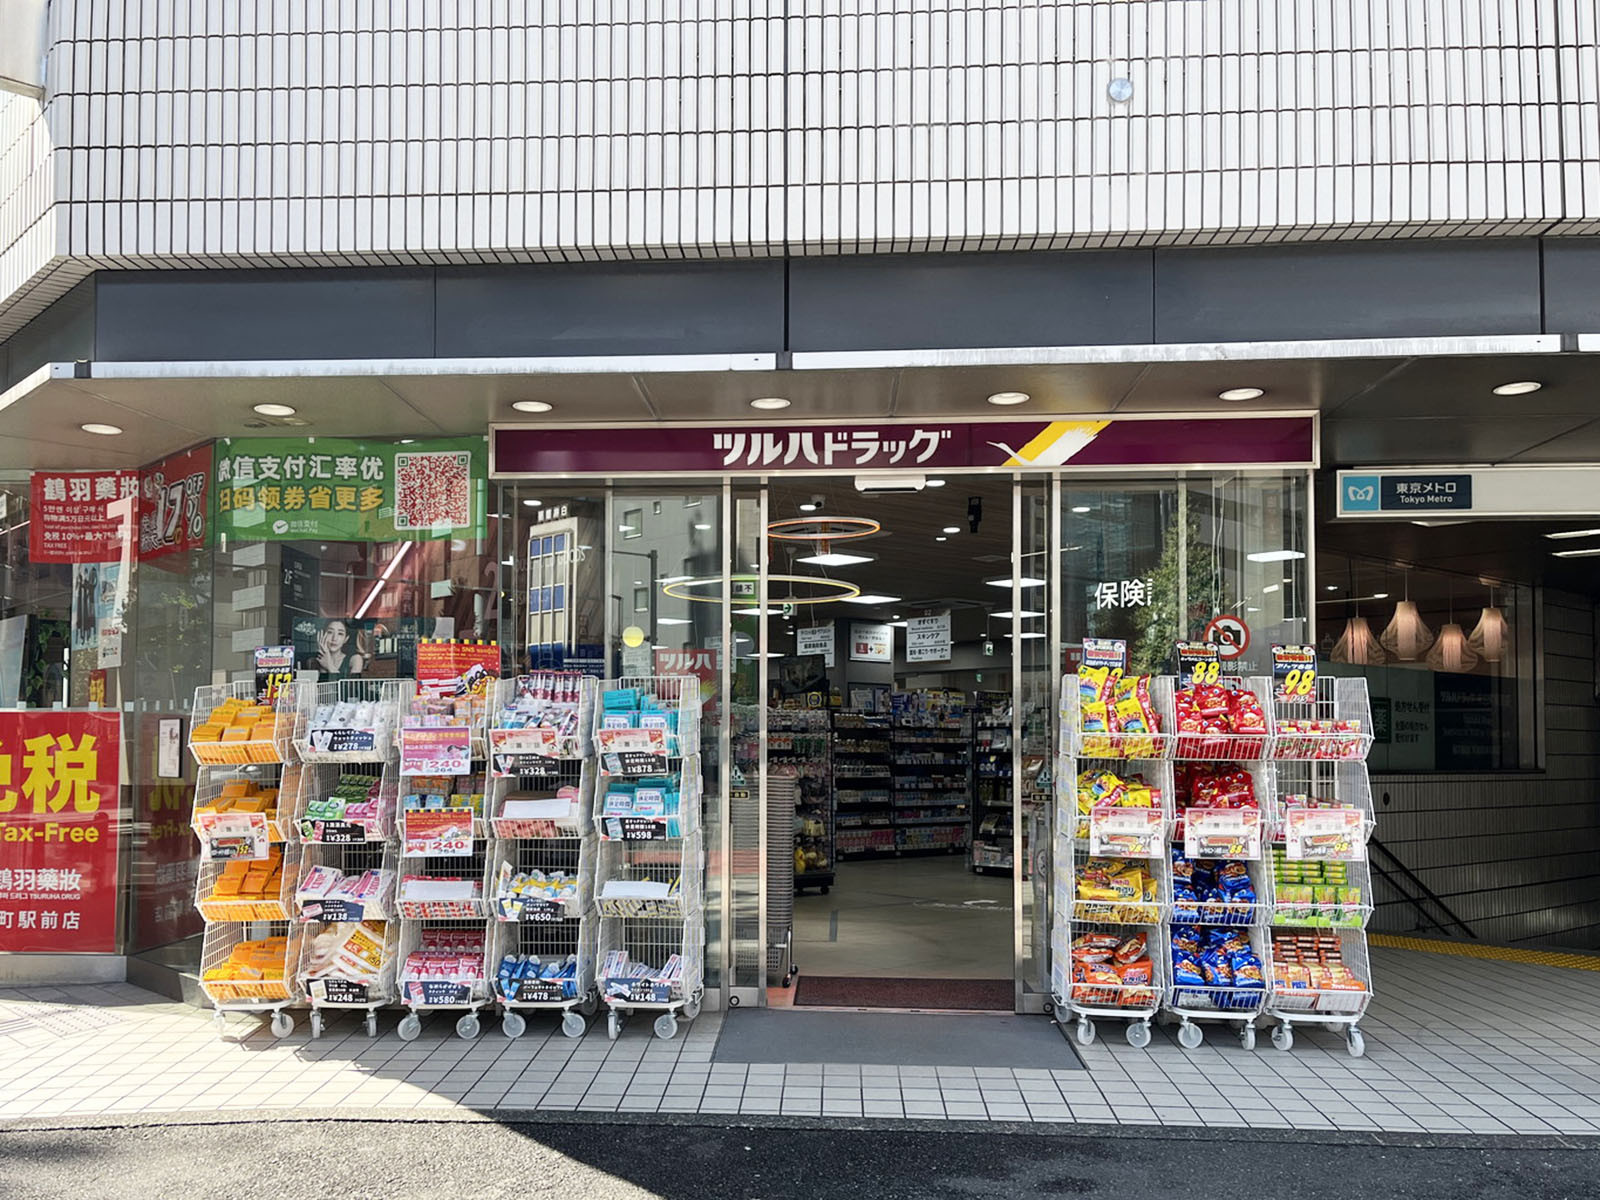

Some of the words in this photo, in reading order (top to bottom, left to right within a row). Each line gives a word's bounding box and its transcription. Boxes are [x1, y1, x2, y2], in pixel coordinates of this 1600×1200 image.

[713, 429, 951, 466] ツルハドラッグ
[43, 476, 139, 502] 鶴羽藥妝
[186, 472, 205, 497] OFF
[1396, 482, 1456, 494] 東京メトロ
[1400, 495, 1425, 504] Tokyo
[1427, 494, 1453, 503] Metro
[658, 653, 713, 670] ツルハ
[1192, 661, 1220, 684] 88
[1285, 669, 1315, 696] 98
[429, 760, 462, 768] 240
[0, 823, 99, 842] Tax-Free
[432, 840, 465, 849] 240
[0, 910, 80, 930] 町駅前店
